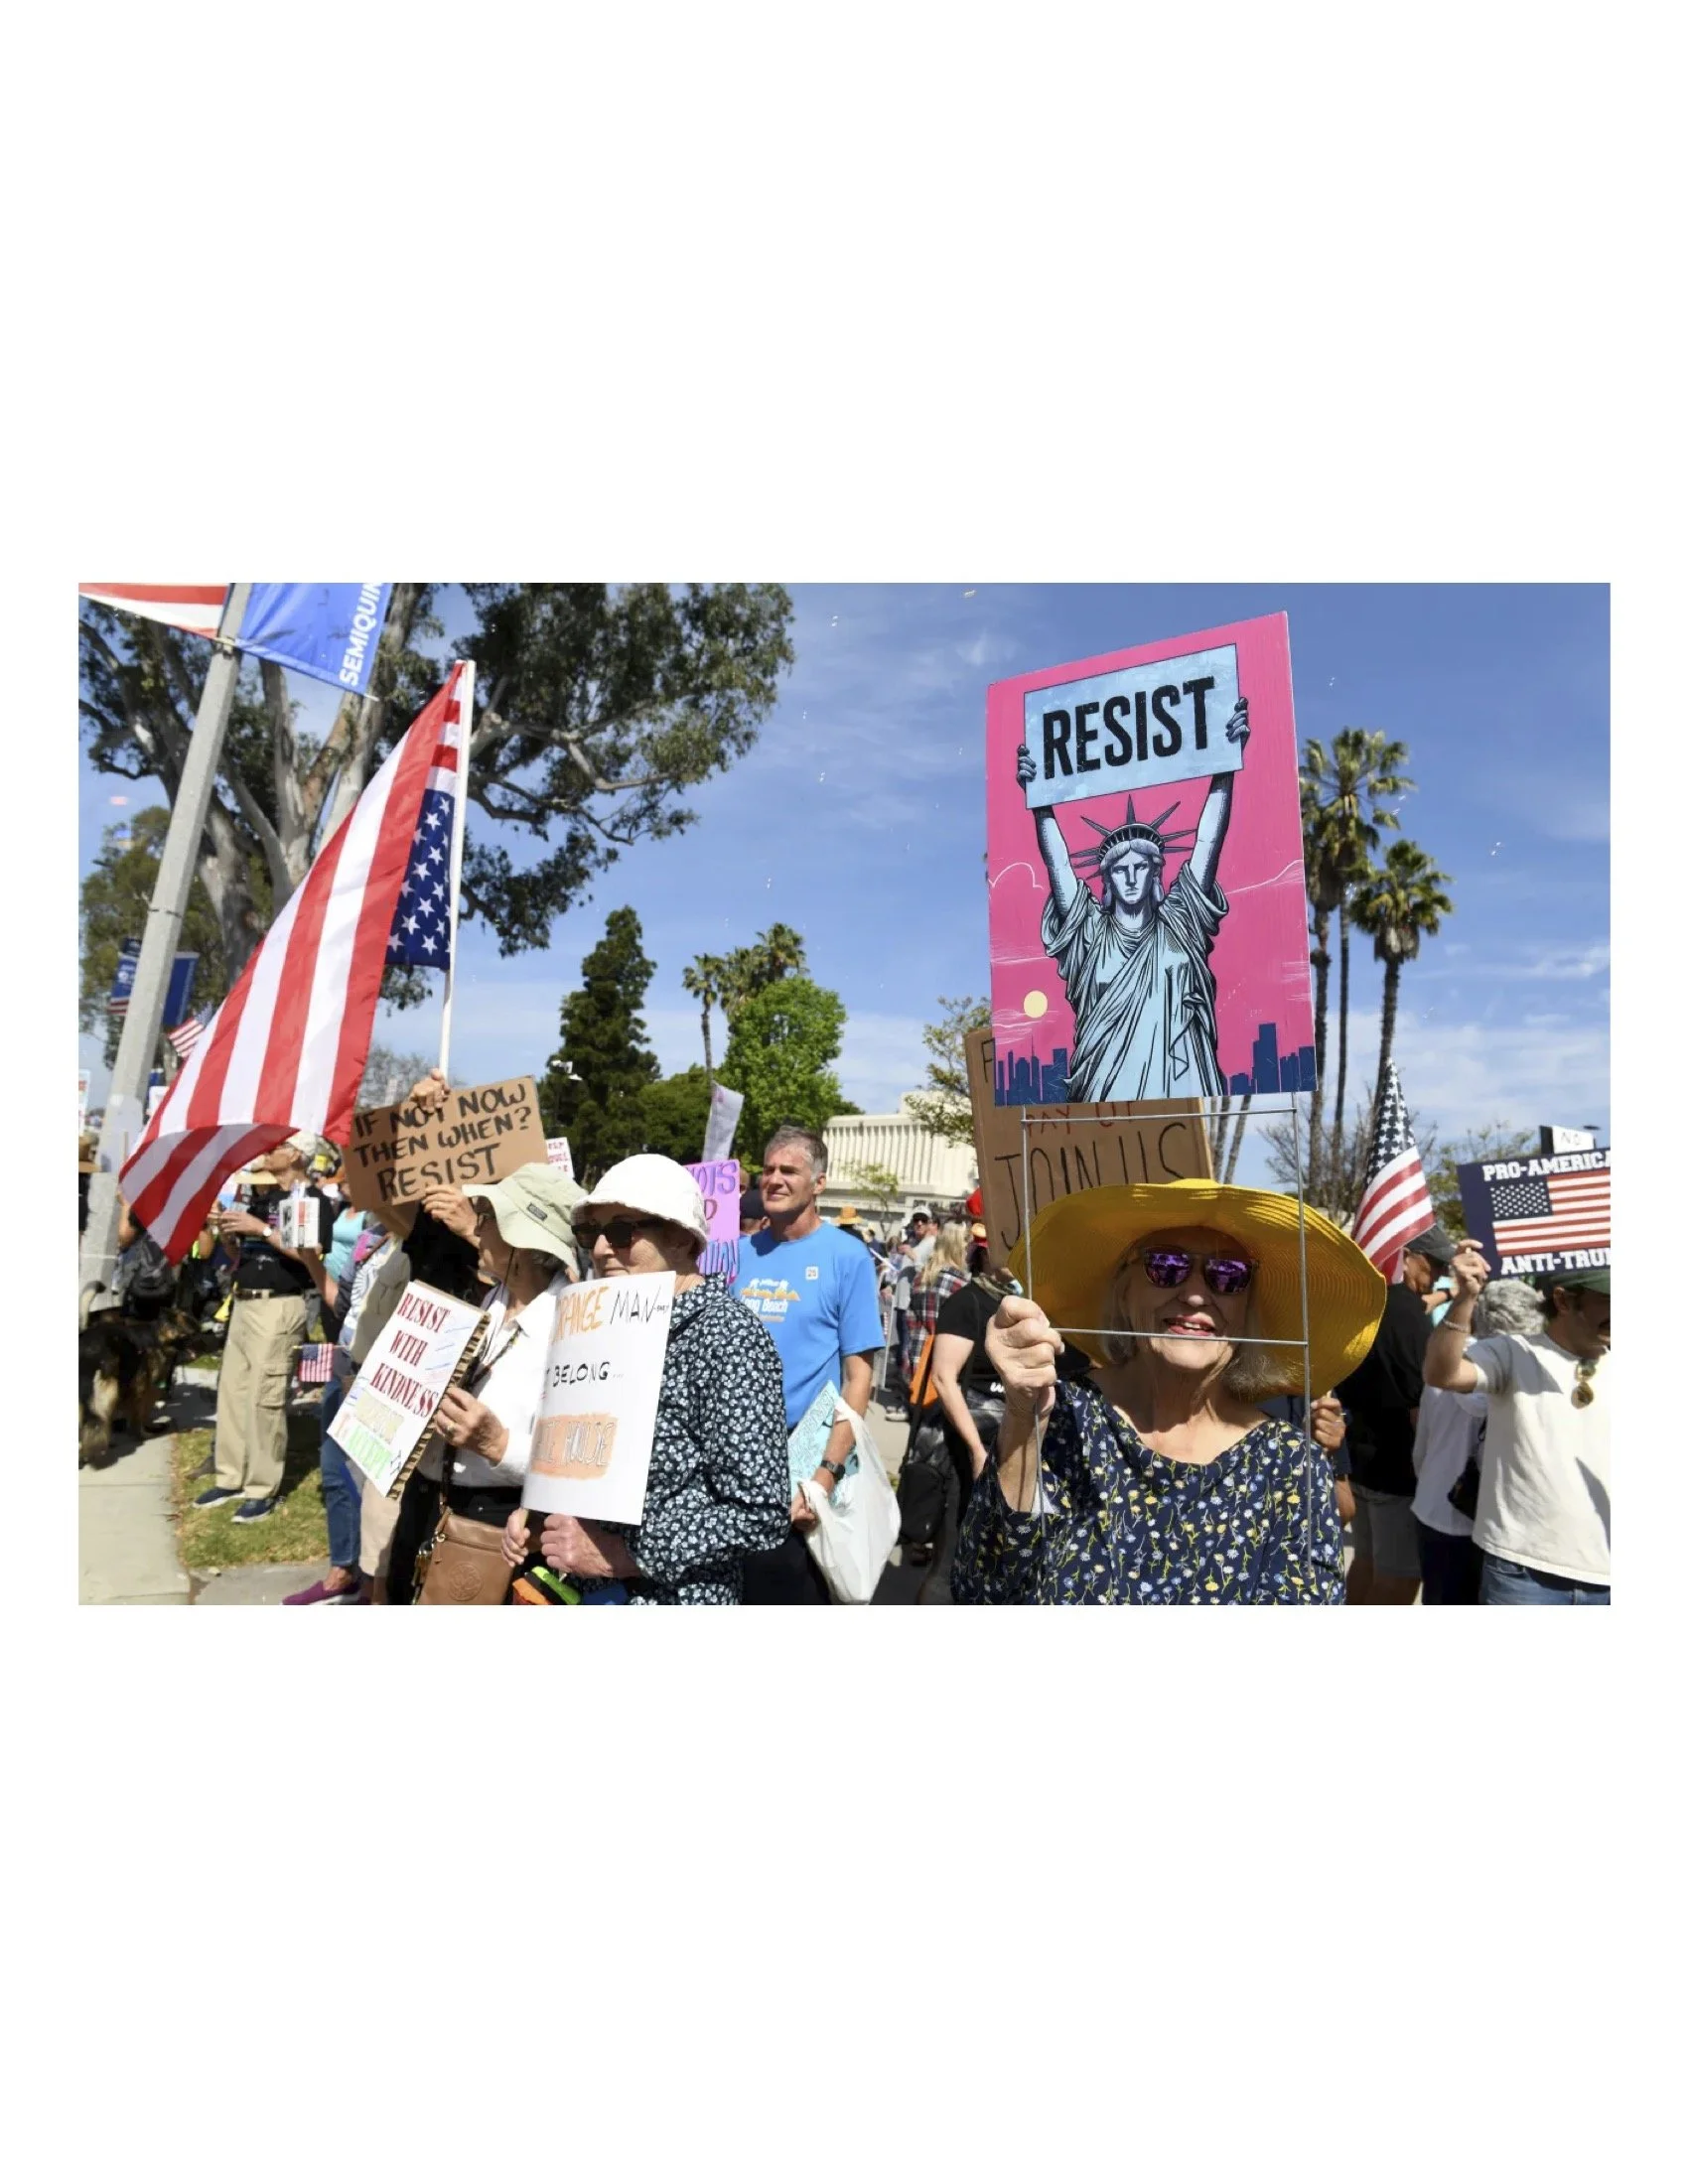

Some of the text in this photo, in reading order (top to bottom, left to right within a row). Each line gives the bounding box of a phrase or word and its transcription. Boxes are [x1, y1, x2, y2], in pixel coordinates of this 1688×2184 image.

[1043, 673, 1215, 780] RESIST
[353, 1105, 532, 1168] THEN WHEN?
[355, 1113, 379, 1138] IF
[458, 1083, 526, 1118] NOW
[376, 1142, 501, 1202] RESIST
[396, 1293, 452, 1334] RESIST
[388, 1329, 429, 1367] WITH
[369, 1362, 440, 1419] KINDNESS
